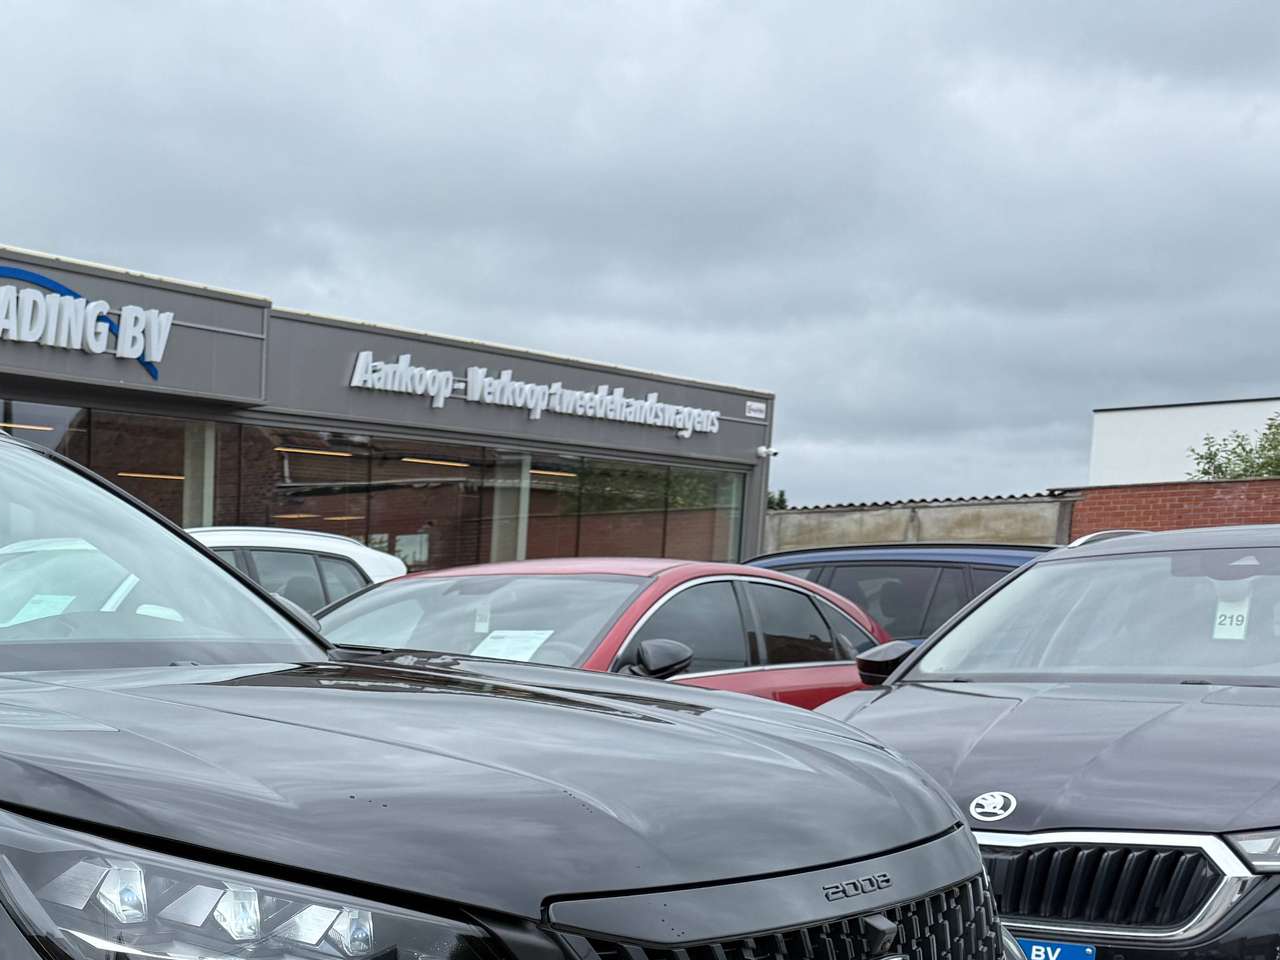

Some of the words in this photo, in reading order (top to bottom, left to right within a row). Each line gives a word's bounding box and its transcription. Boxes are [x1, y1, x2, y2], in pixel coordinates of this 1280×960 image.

[116, 304, 174, 363] BV
[350, 351, 454, 409] Aankoop
[466, 366, 549, 419] Verkoop
[1218, 614, 1245, 626] 219
[822, 872, 893, 902] 2008
